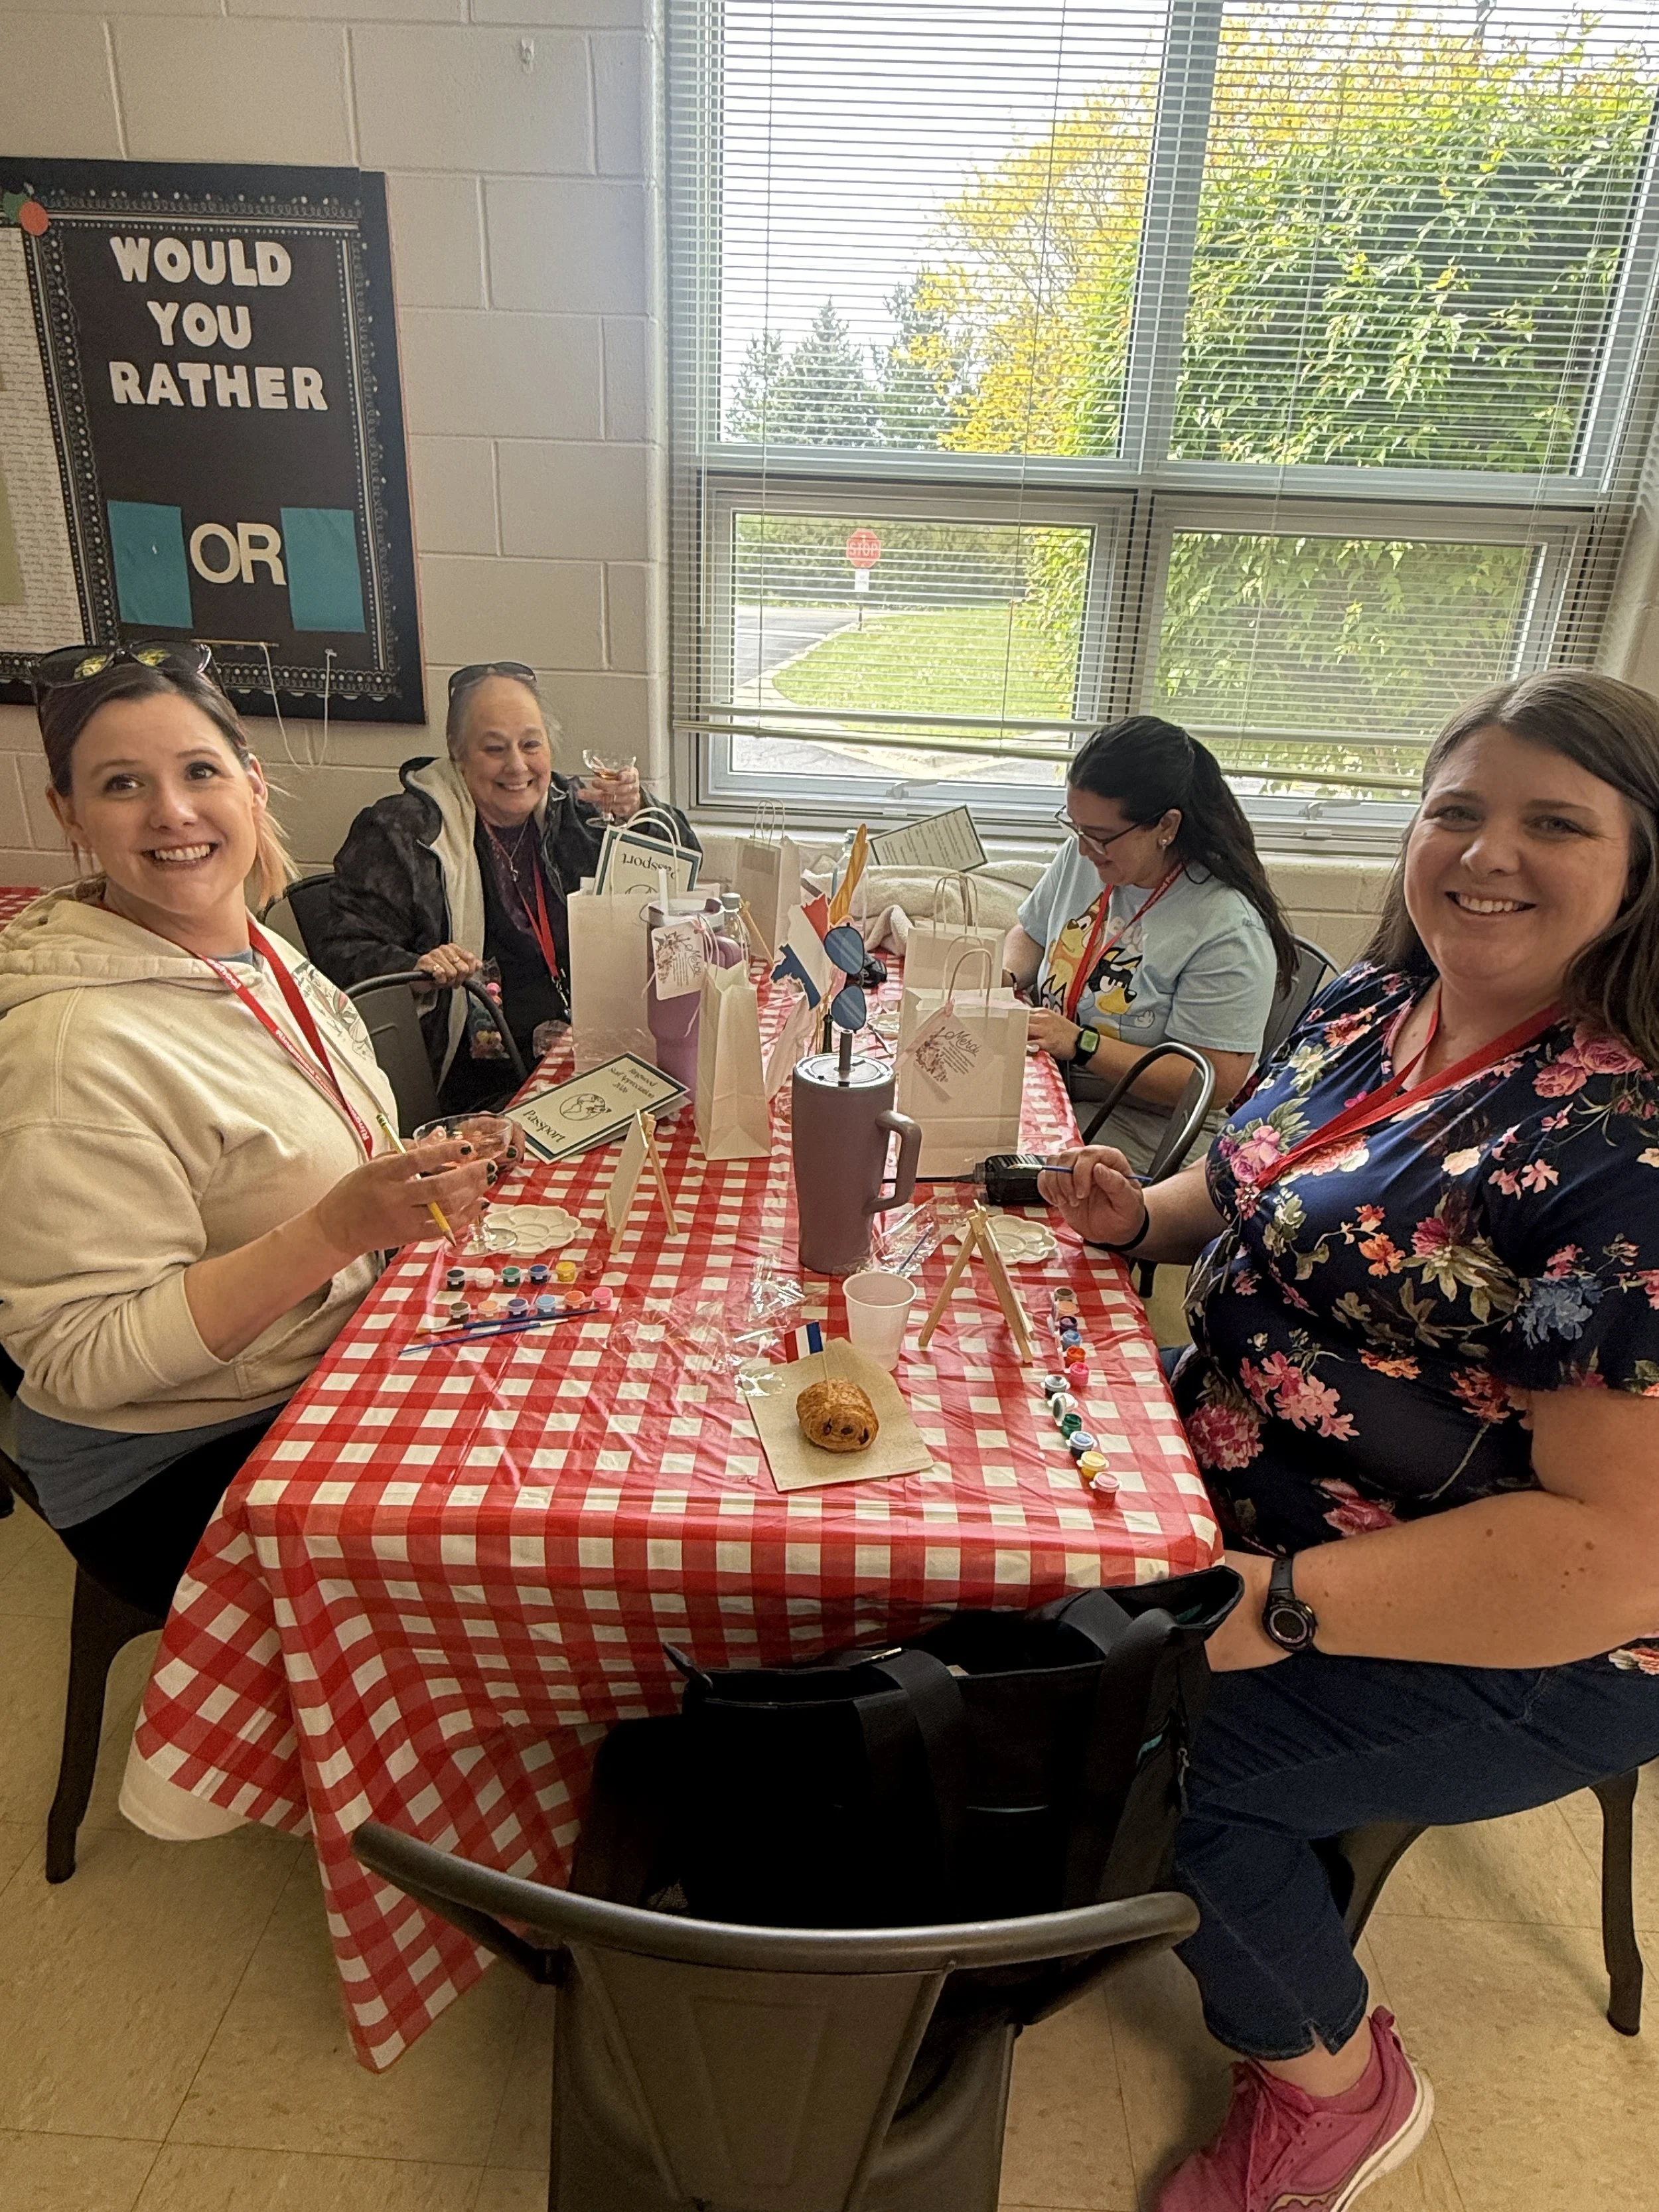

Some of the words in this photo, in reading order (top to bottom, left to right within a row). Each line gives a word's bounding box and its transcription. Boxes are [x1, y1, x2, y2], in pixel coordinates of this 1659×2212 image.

[110, 236, 292, 287] WOULD
[147, 301, 252, 349] YOU
[109, 361, 329, 411] RATHER
[190, 522, 286, 585] OR
[849, 543, 878, 555] STOP
[523, 1109, 566, 1143] Passport
